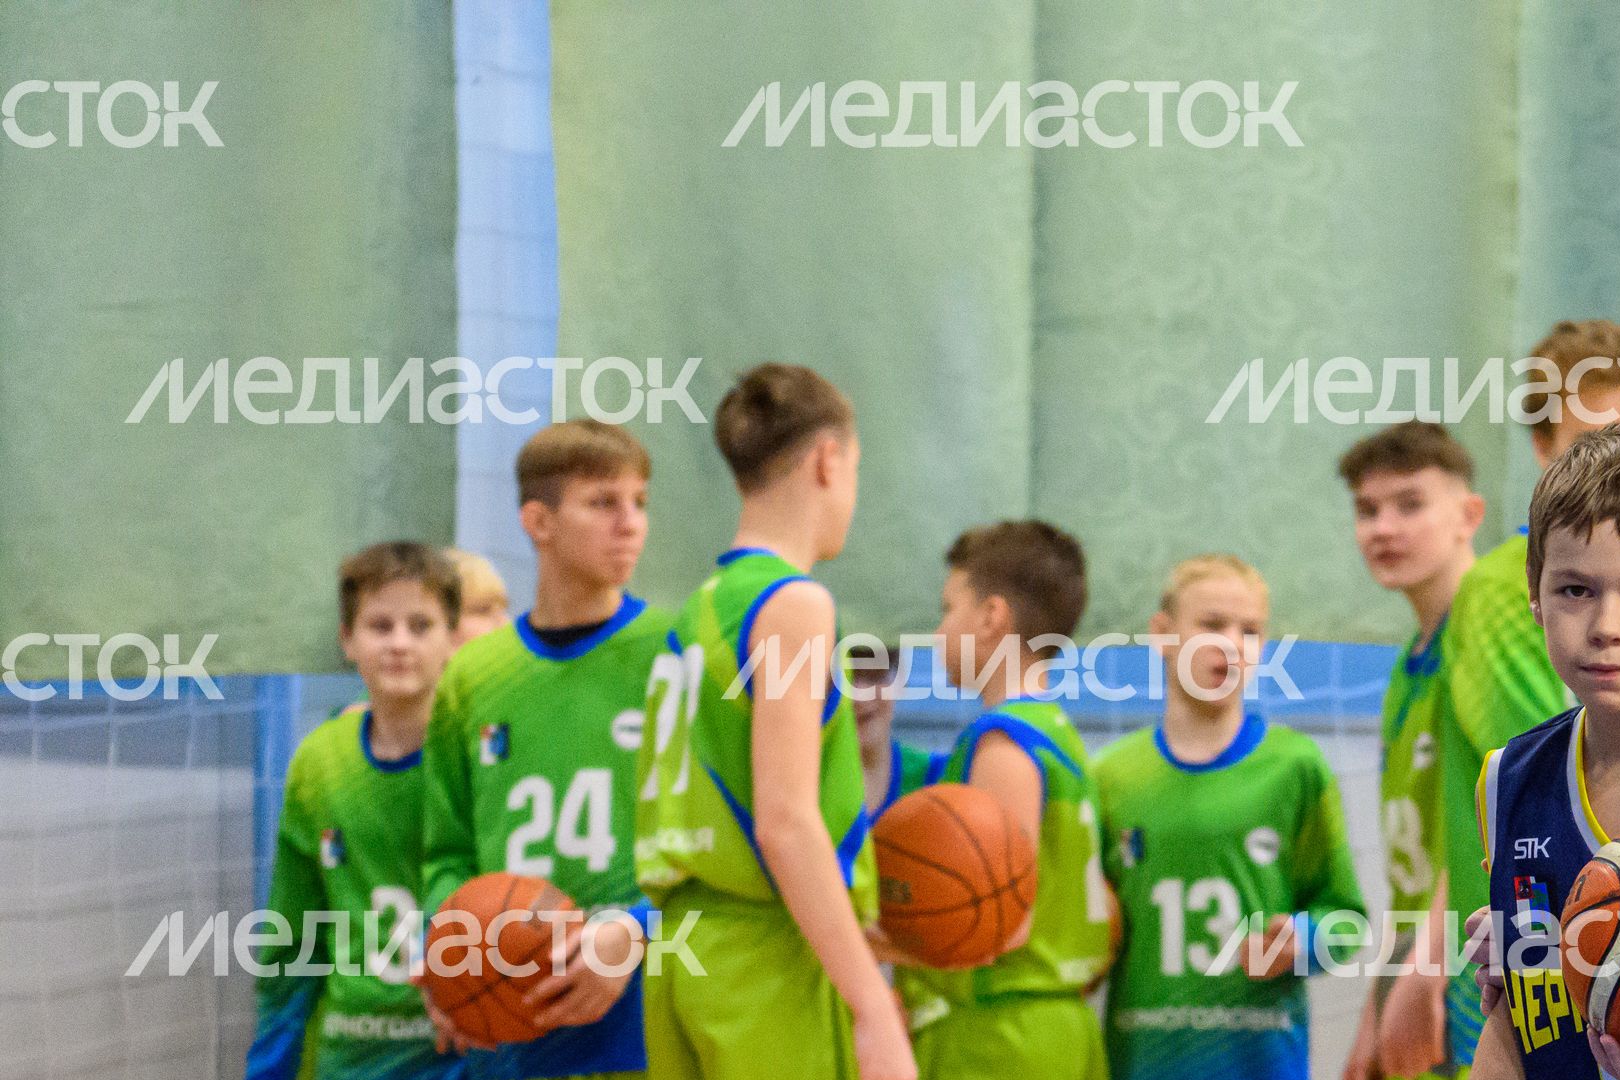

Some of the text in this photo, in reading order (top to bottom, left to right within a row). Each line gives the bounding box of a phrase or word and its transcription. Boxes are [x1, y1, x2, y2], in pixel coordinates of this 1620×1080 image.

[506, 766, 616, 876] 24
[1514, 837, 1551, 860] STK
[1151, 876, 1242, 977] 13
[1501, 968, 1584, 1055] ЧЕР
